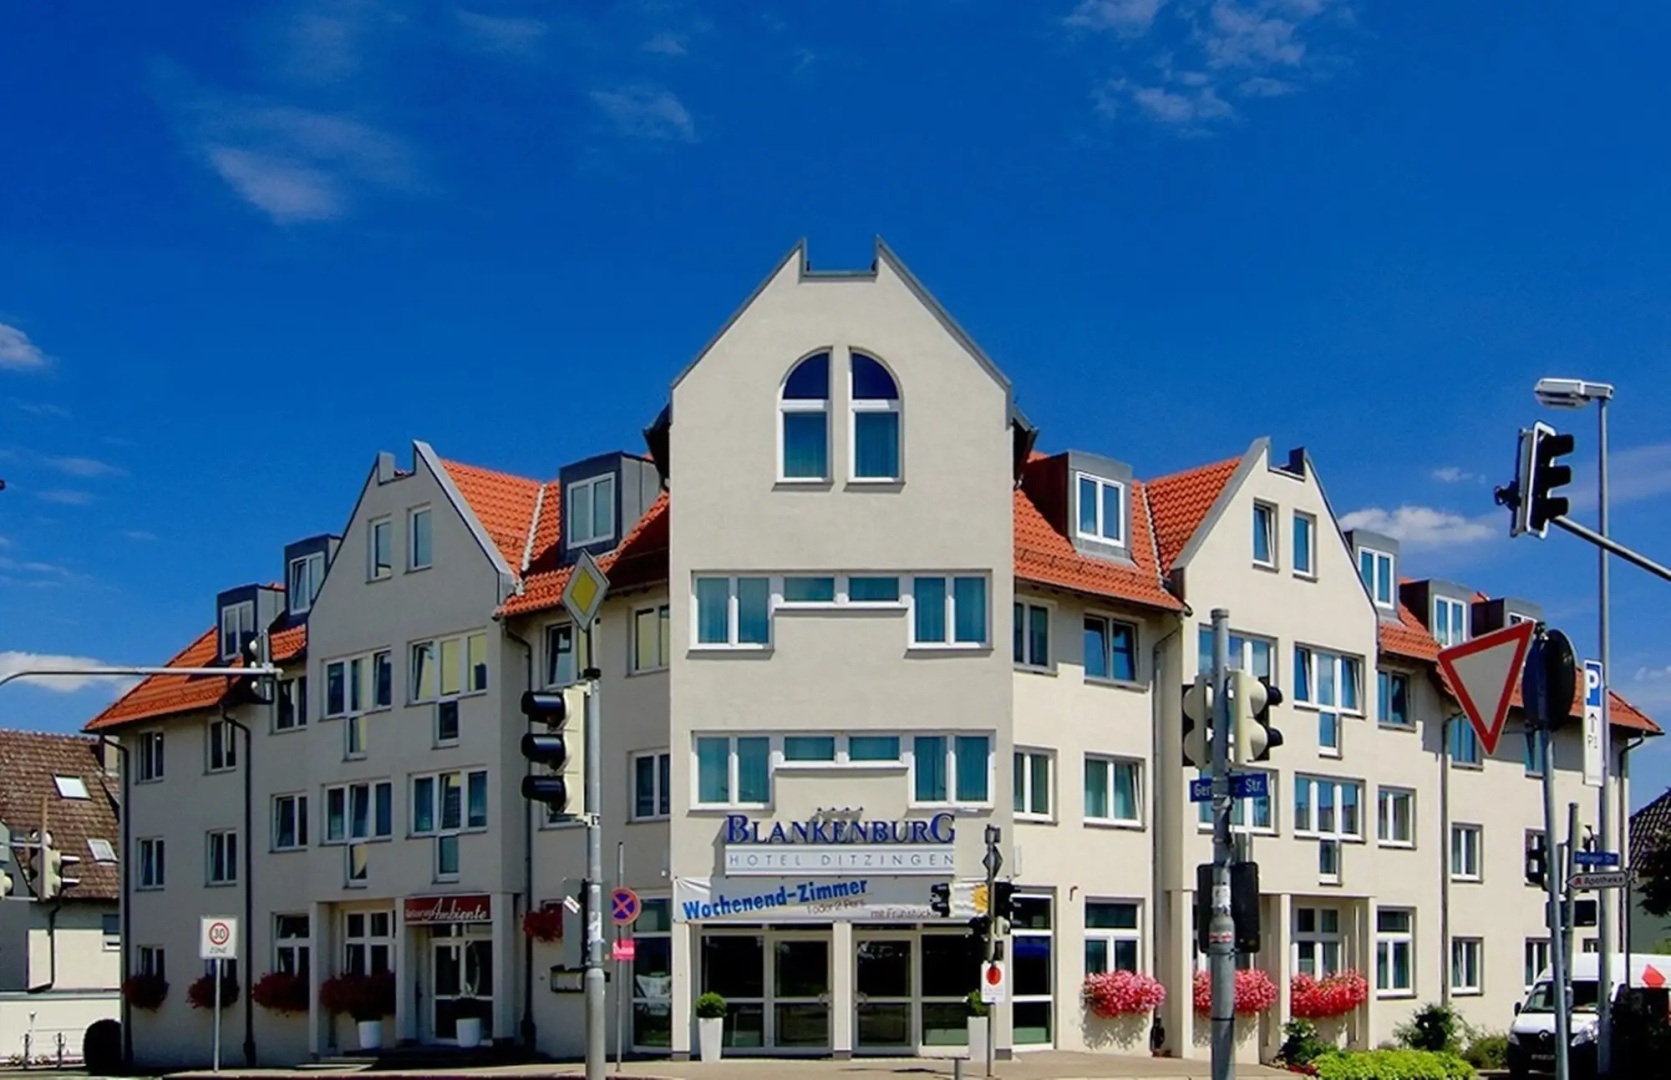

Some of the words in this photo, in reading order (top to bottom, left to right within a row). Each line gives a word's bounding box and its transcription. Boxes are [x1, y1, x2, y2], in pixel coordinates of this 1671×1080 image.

[1585, 667, 1600, 700] P
[1245, 778, 1265, 793] Str.
[726, 812, 956, 844] BLANKENBURG
[729, 854, 801, 866] HOTEL
[821, 854, 955, 866] DITZINGEN
[682, 879, 869, 920] Wochenend-Zimmer
[213, 928, 226, 940] 30
